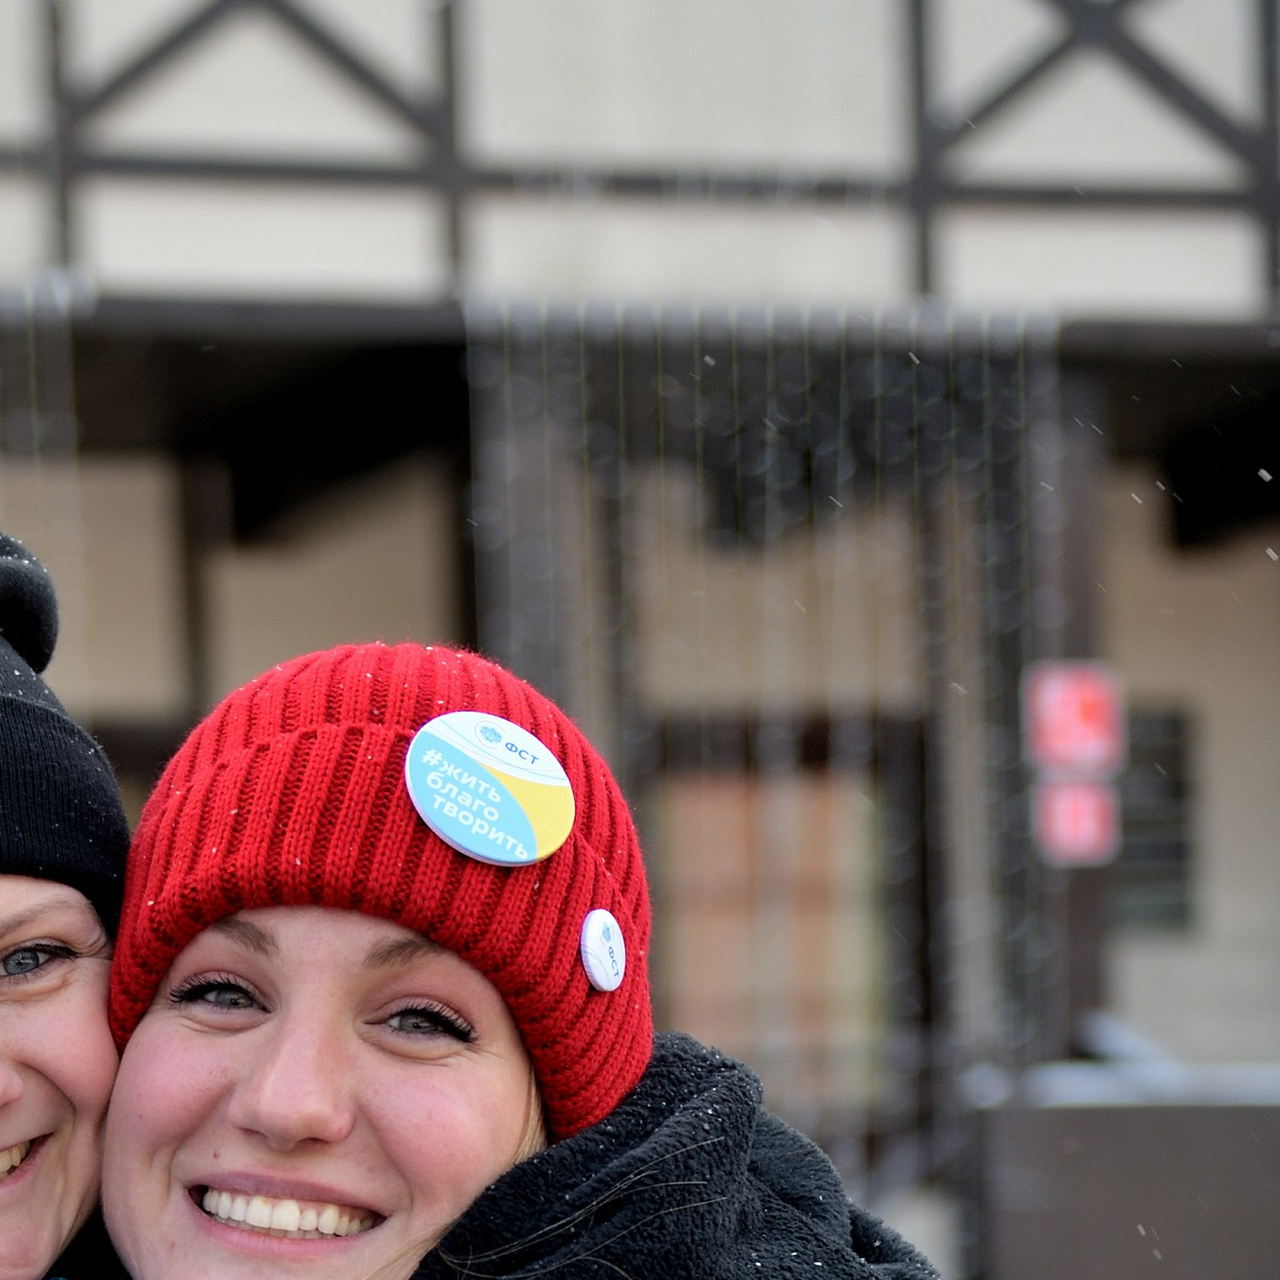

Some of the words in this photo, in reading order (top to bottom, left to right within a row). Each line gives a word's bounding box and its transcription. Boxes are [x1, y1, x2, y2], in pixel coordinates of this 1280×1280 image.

[421, 748, 502, 803] #жить
[504, 742, 539, 765] ФСТ
[425, 771, 500, 821] благо
[432, 793, 529, 860] творить
